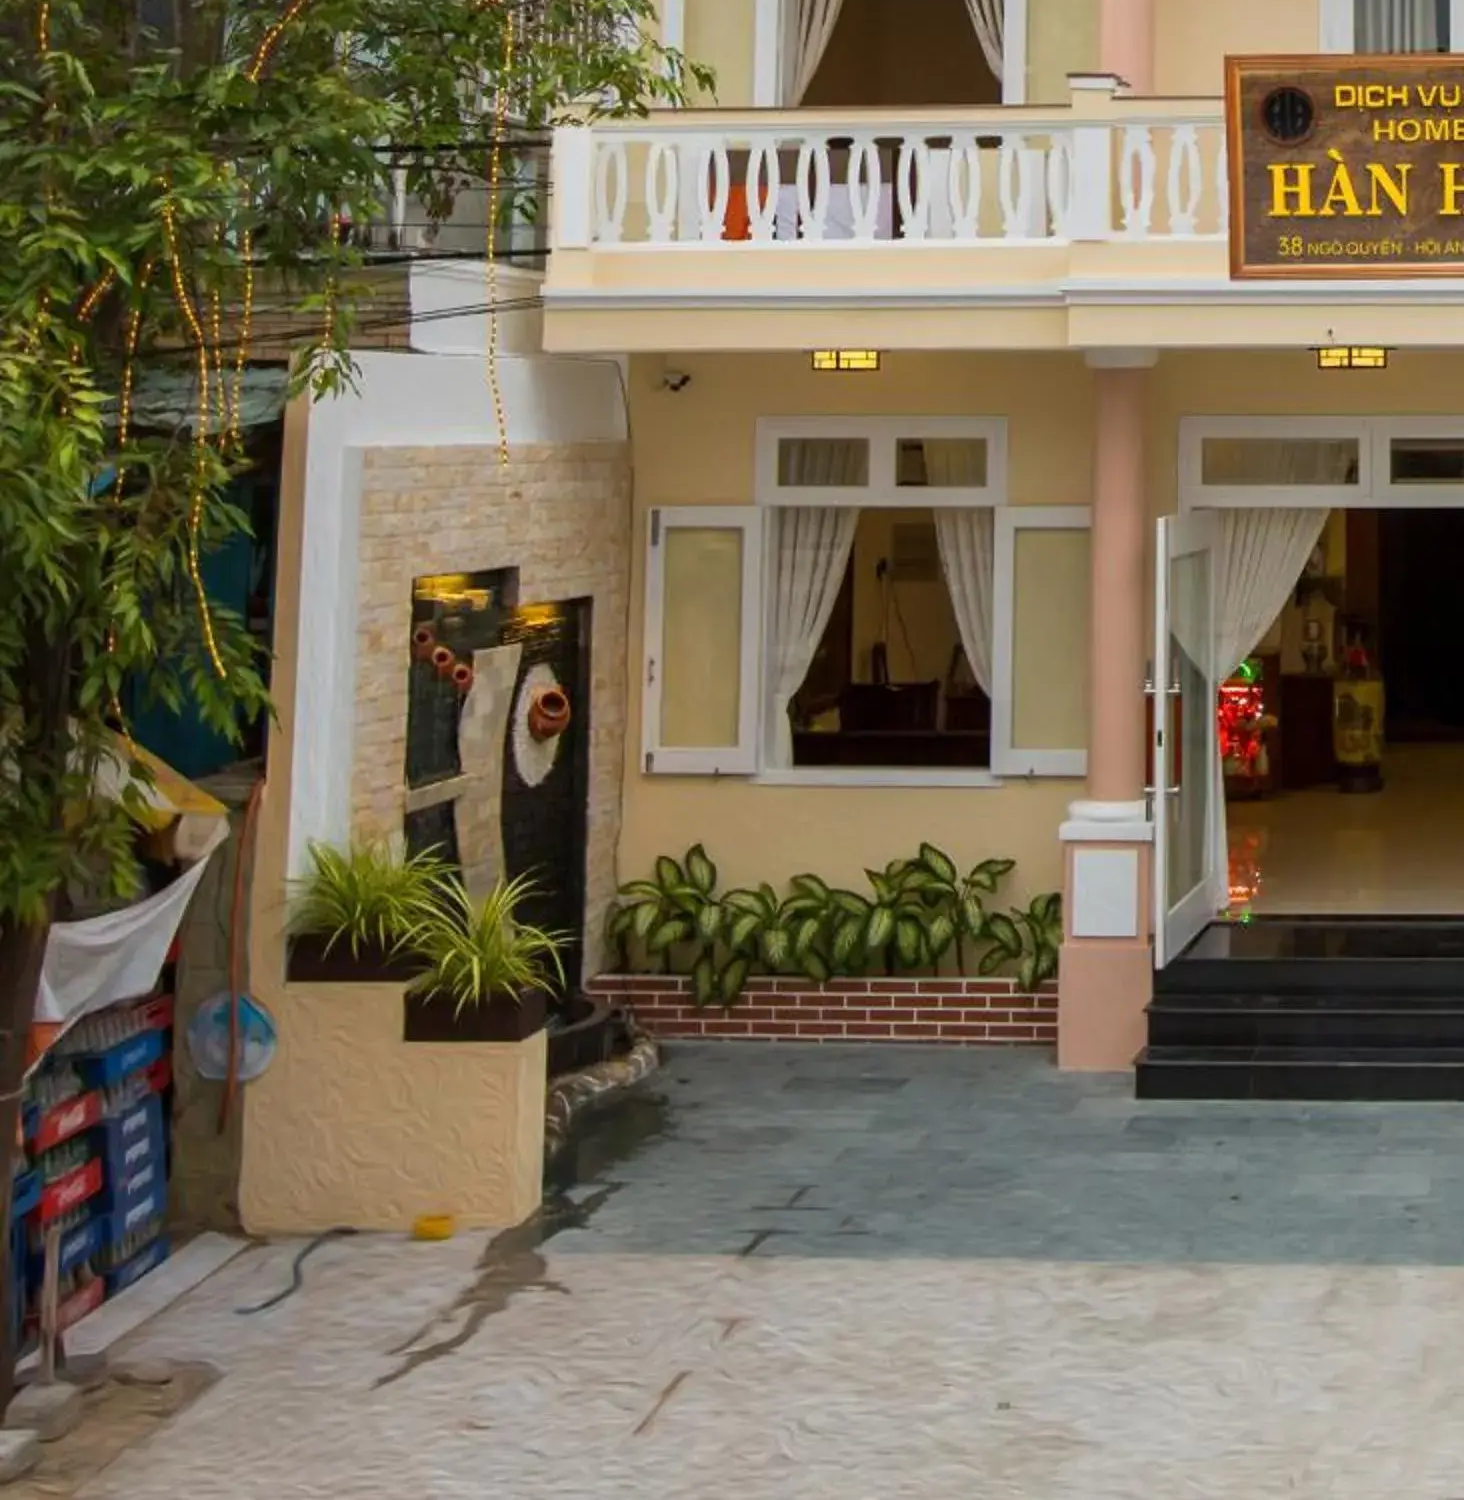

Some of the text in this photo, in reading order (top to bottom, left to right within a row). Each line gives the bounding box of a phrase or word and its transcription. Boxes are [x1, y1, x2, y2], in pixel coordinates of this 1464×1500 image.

[1334, 84, 1409, 113] DỊCH
[1267, 148, 1414, 217] HÀN
[1278, 235, 1304, 257] 38
